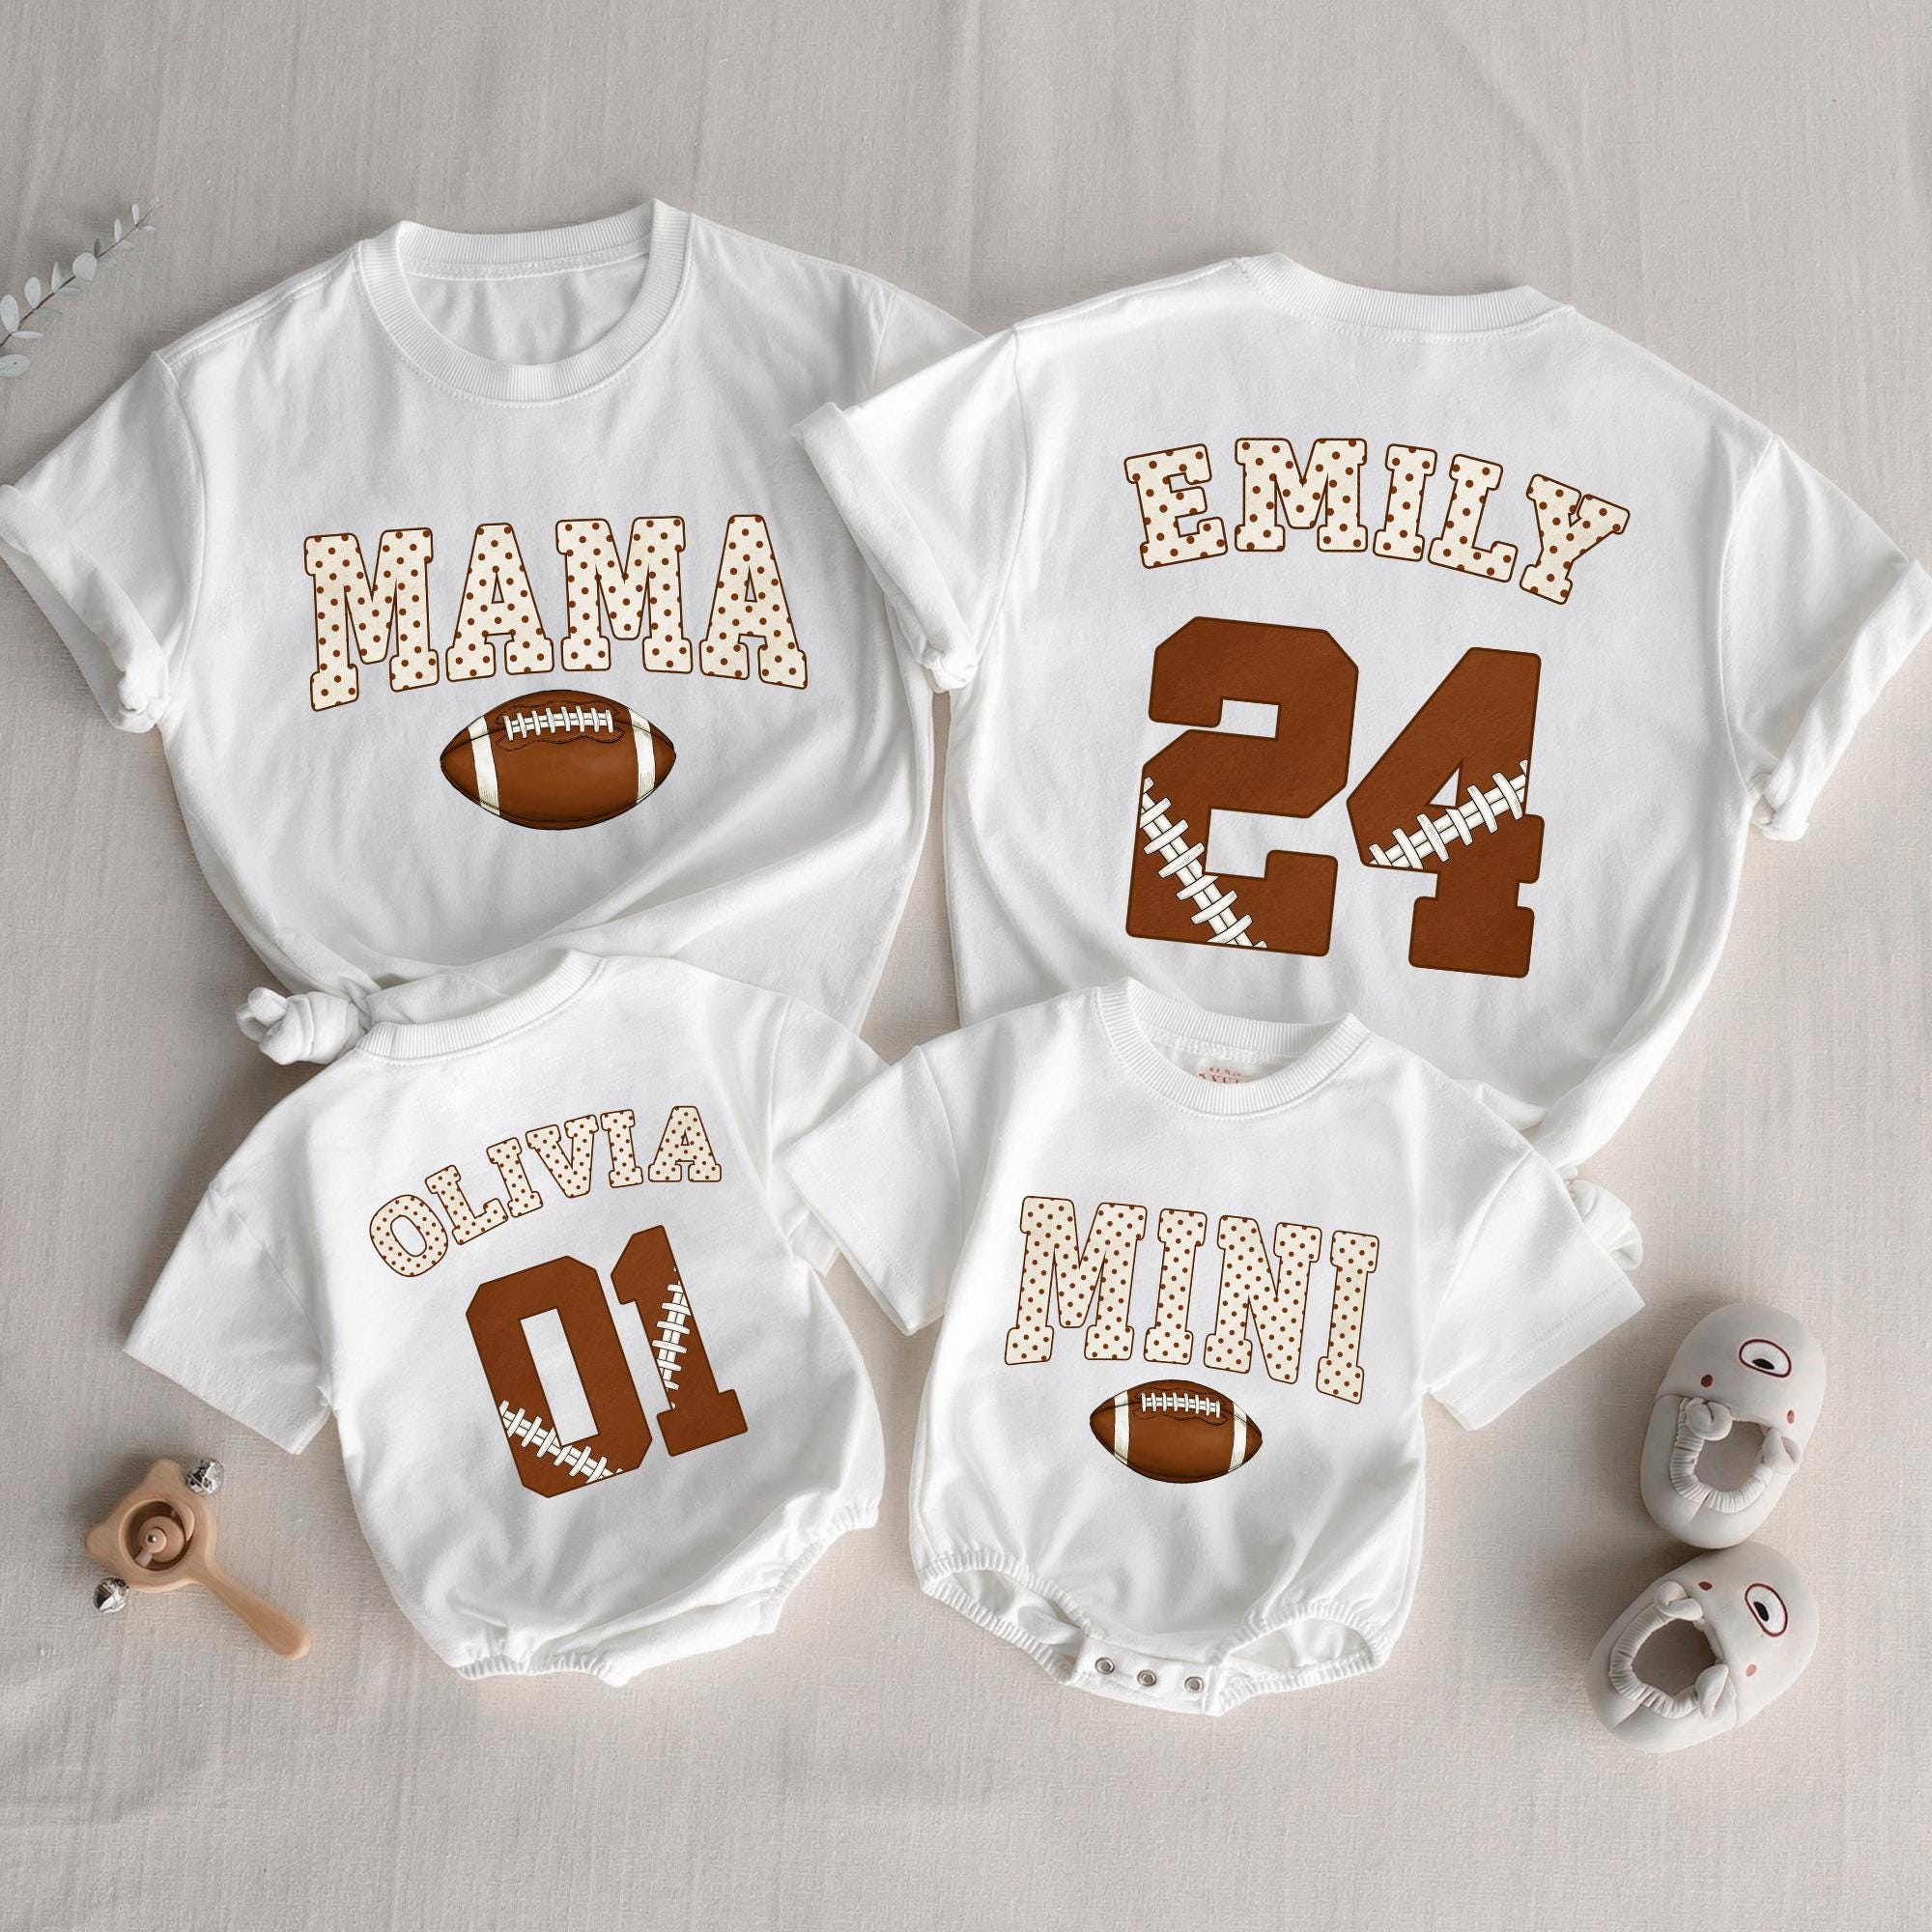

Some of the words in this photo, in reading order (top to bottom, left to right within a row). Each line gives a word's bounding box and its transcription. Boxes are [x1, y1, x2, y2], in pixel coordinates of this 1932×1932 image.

[304, 515, 808, 712] MAMA
[1124, 438, 1630, 605] EMILY
[1126, 616, 1545, 978] 24
[370, 1106, 722, 1277] OLIVIA
[466, 1225, 748, 1498] 01
[1005, 1196, 1379, 1404] MINI
